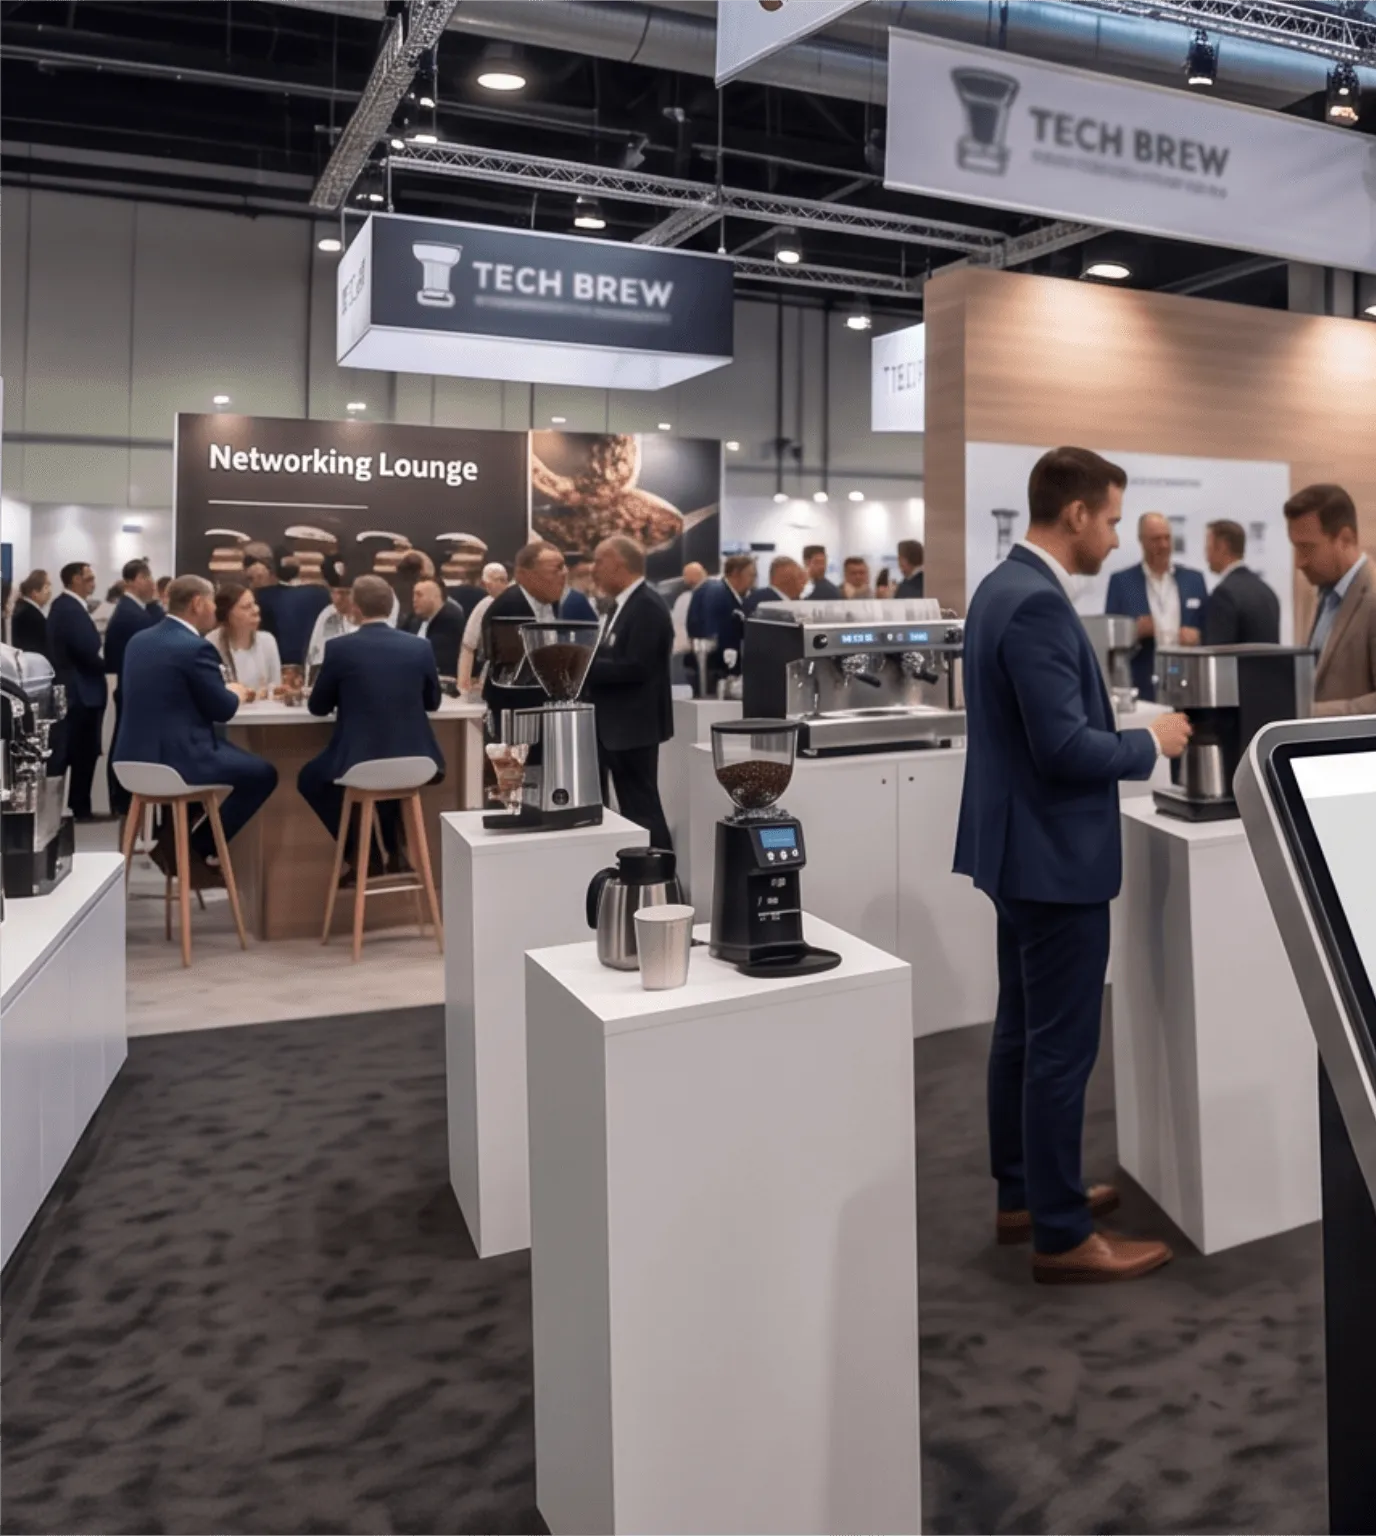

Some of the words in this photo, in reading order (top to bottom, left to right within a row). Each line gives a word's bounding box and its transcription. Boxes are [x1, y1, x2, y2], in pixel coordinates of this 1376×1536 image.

[1029, 106, 1123, 157] TECH
[1133, 127, 1230, 178] BREW
[472, 261, 562, 297] TECH
[573, 272, 674, 308] BREW
[209, 443, 372, 481] Networking
[379, 452, 478, 486] Lounge
